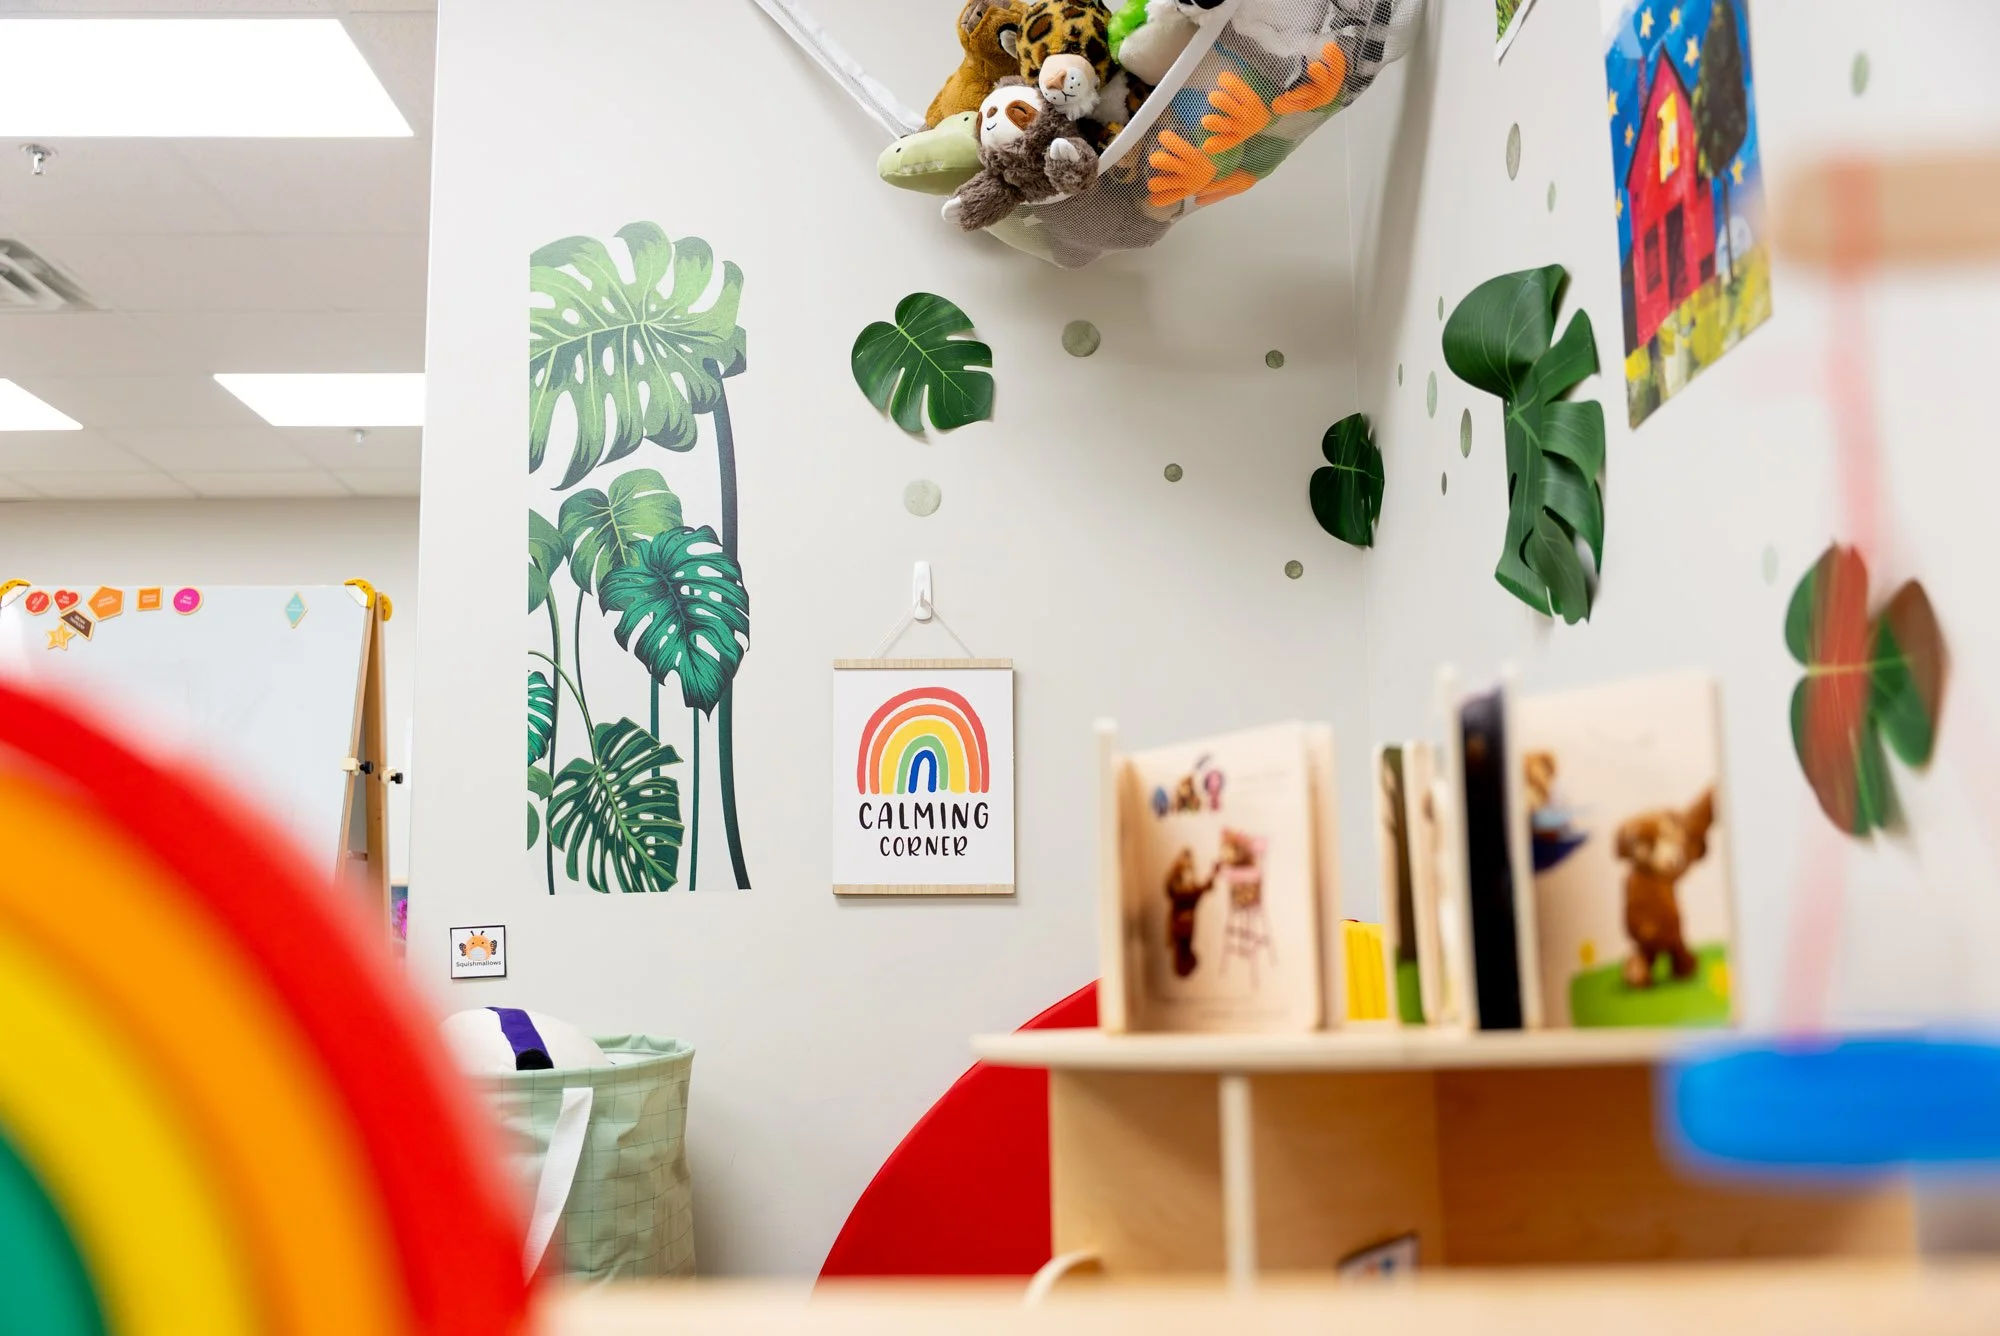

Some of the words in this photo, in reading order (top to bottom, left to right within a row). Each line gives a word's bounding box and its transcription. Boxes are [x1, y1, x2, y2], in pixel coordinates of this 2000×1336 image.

[859, 802, 989, 830] CALMING
[880, 836, 968, 857] CORNER
[456, 960, 502, 968] Squishmallows
